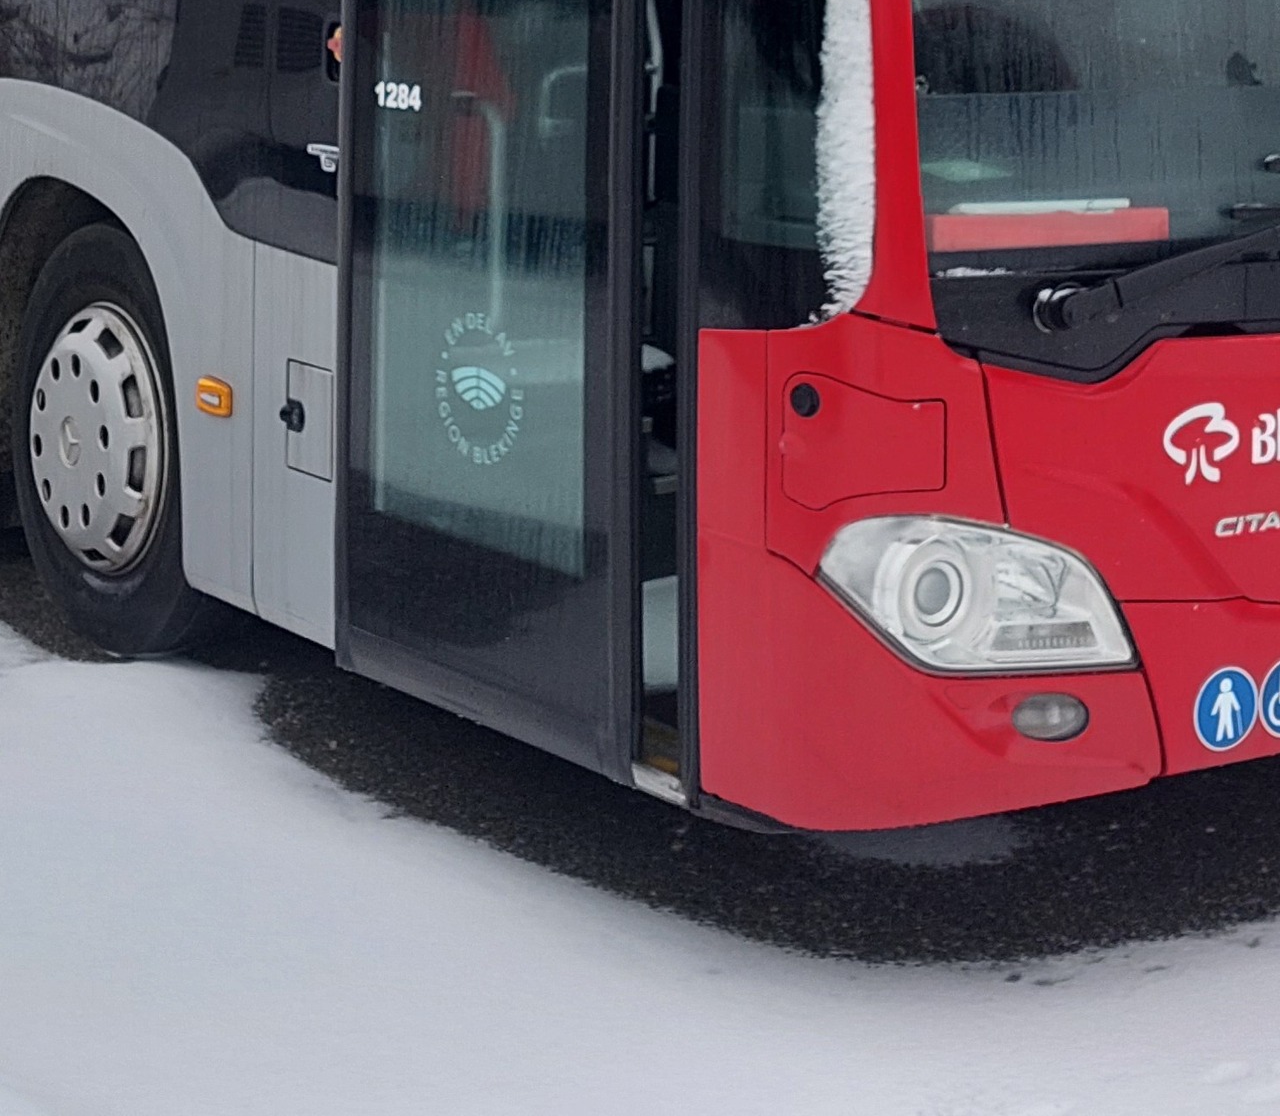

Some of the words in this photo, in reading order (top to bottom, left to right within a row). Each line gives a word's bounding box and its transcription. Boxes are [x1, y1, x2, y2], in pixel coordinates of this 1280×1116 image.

[374, 80, 422, 113] 1284
[445, 317, 464, 345] EN
[464, 312, 493, 335] DEL
[495, 332, 516, 356] AV
[435, 369, 469, 456] REGION
[472, 389, 524, 465] BLEKINGE
